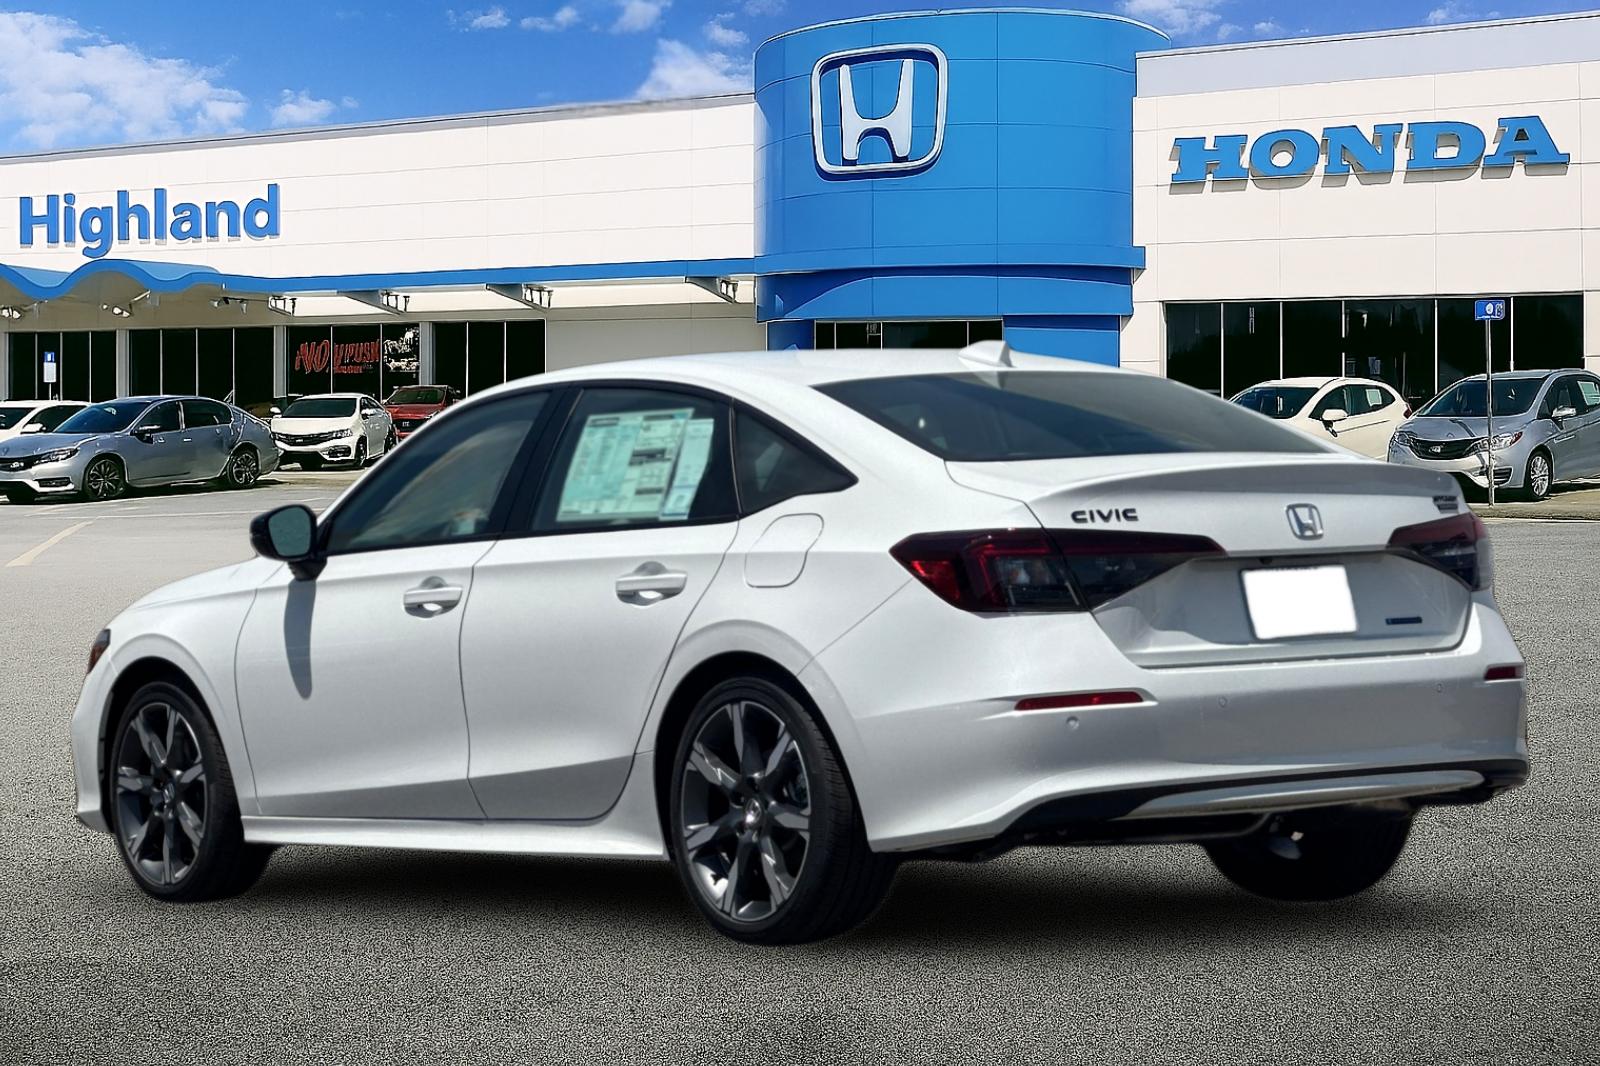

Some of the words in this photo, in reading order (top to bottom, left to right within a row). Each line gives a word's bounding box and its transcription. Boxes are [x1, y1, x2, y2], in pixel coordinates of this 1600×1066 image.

[1171, 115, 1570, 183] HONDA
[19, 183, 280, 259] Highland
[1070, 507, 1139, 524] CIVIC
